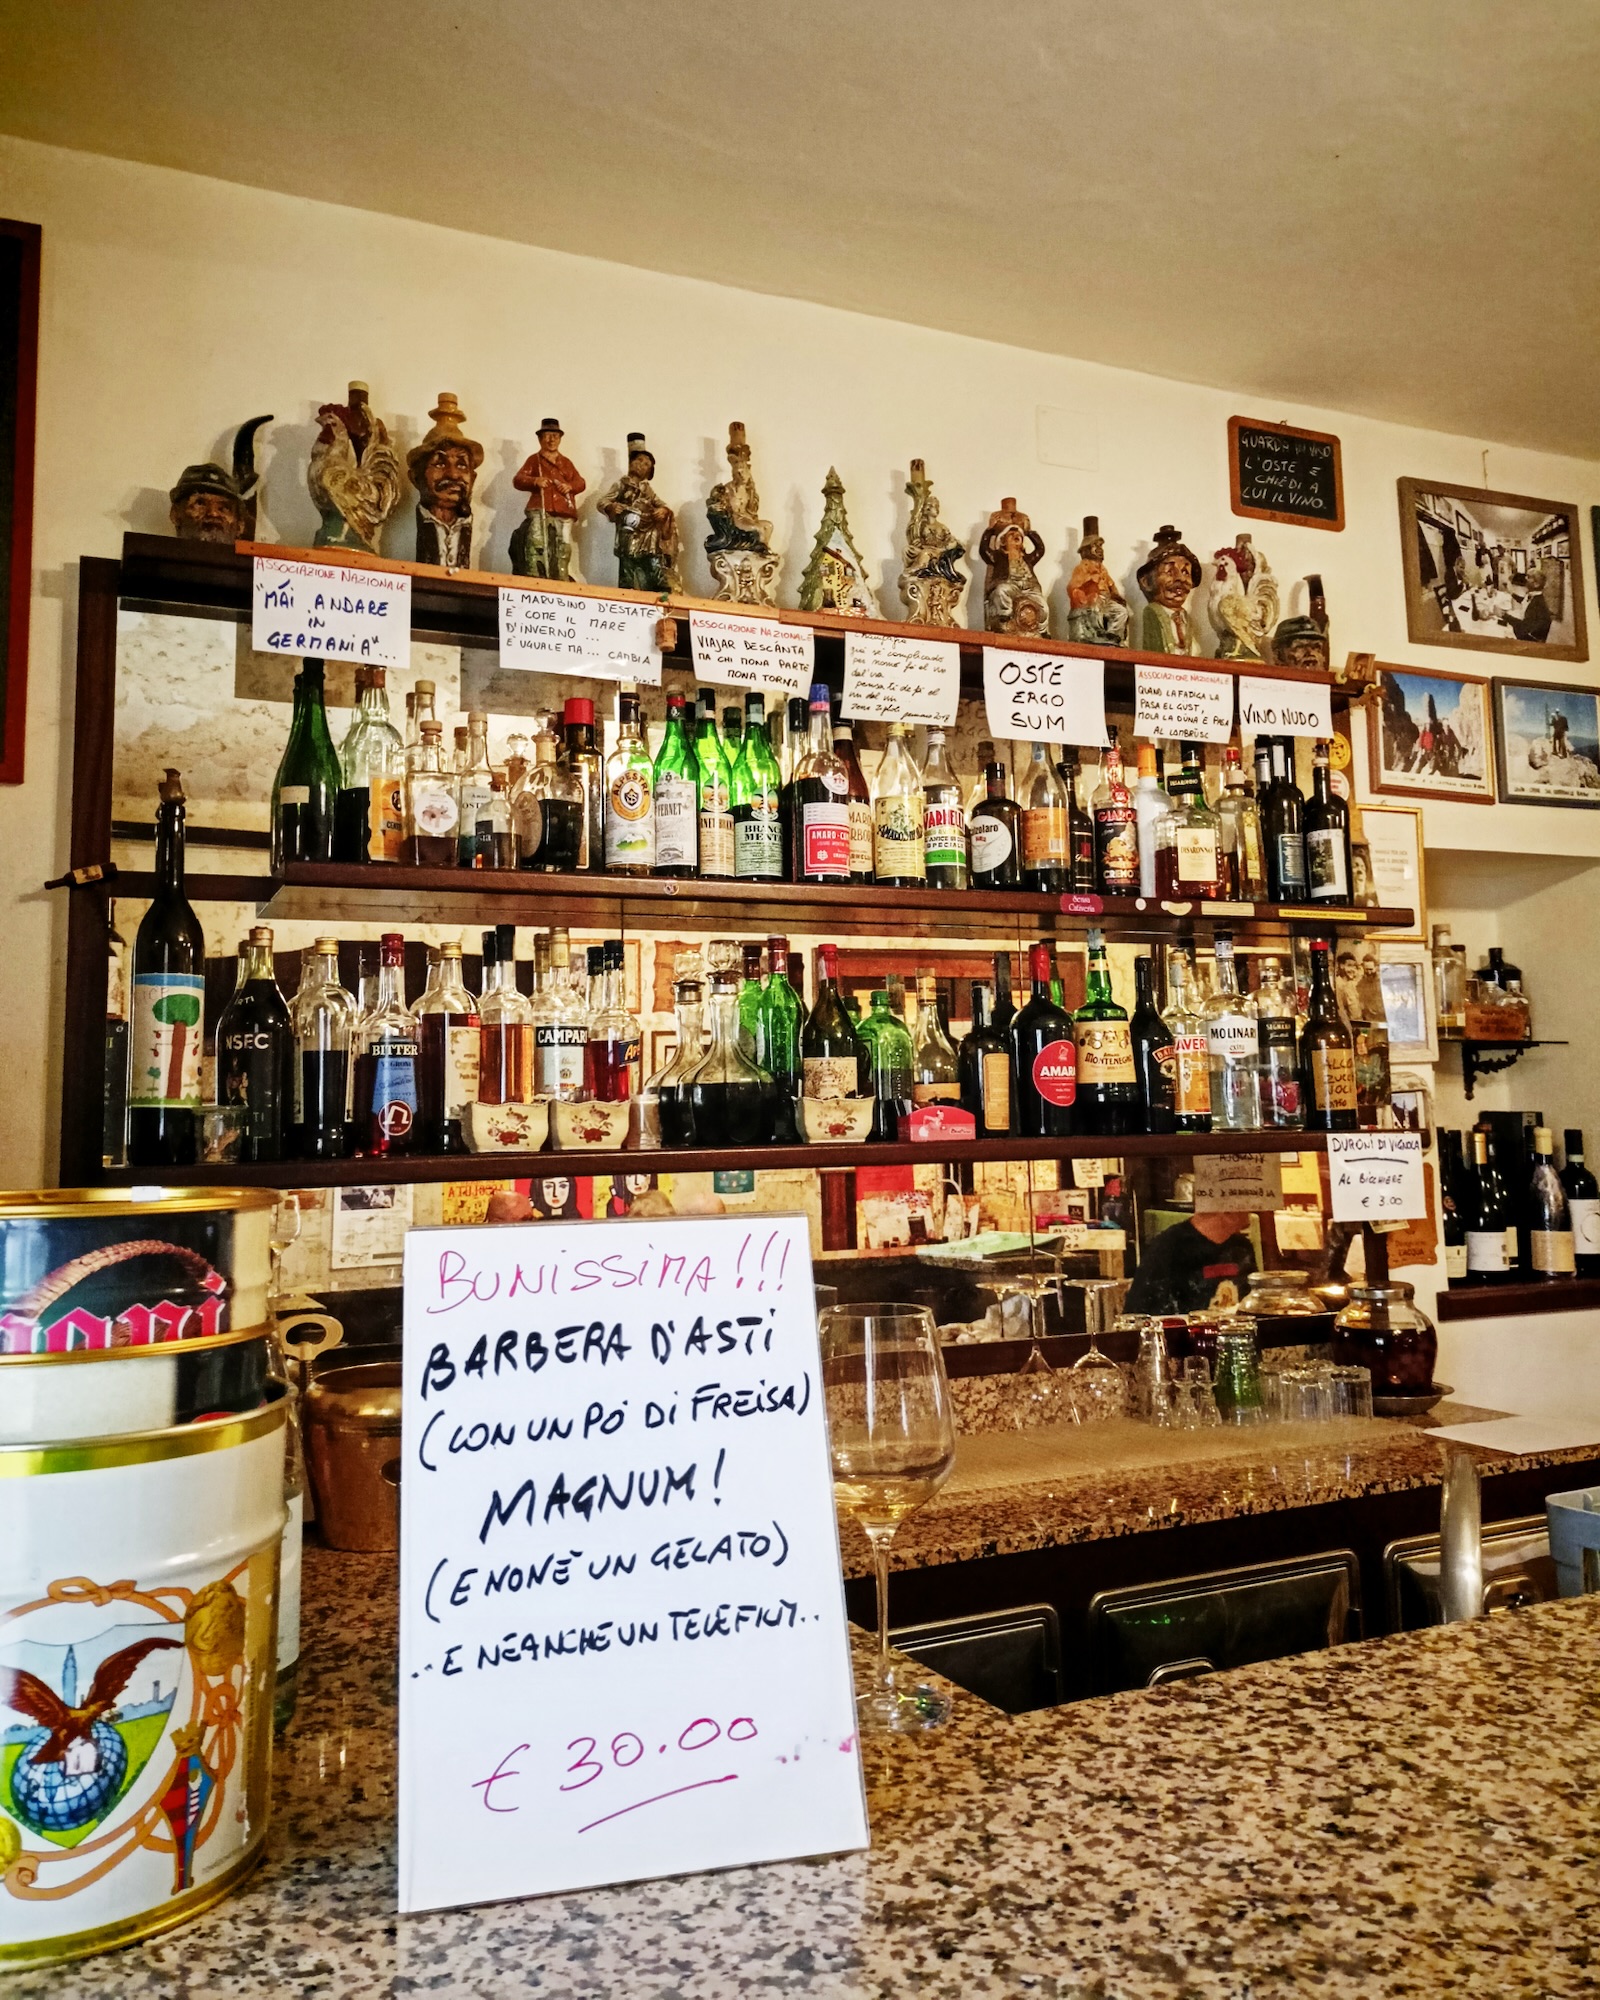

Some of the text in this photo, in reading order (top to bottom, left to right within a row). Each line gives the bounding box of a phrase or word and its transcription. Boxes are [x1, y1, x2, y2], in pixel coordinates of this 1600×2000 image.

[1309, 467, 1321, 476] E
[1255, 475, 1319, 493] CHIEDI A
[1242, 487, 1267, 498] LUI
[1272, 493, 1284, 502] IL
[256, 557, 407, 592] ASSOCIAZIONE NAZIONALE
[315, 593, 389, 617] ANDARE
[502, 593, 656, 619] IL MARUBINO D'ESTATE
[525, 610, 556, 621] COME
[566, 616, 577, 625] IL
[590, 618, 626, 632] MARE
[692, 619, 813, 641] ASSOCIAZIONE NAZIONALE
[506, 622, 576, 639] D'INVERNO
[520, 640, 562, 651] UGUALE
[608, 651, 650, 665] CAMBIA
[697, 635, 736, 652] VIAJAR
[741, 658, 769, 667] MONA
[779, 659, 809, 672] PARTE
[727, 670, 798, 688] MONA TORNA
[1139, 671, 1230, 685] ASSOCIAZIONE NAZIONALE
[1012, 691, 1064, 707] ERGO
[1140, 699, 1160, 709] PASA
[1010, 712, 1064, 731] SUM
[1138, 711, 1159, 721] MOLA
[1213, 715, 1229, 727] PASA
[1243, 703, 1319, 727] VINO NUDO
[1153, 726, 1163, 735] AL
[612, 771, 650, 797] ALPESTRE
[538, 1029, 588, 1044] CAMPARI
[1210, 1026, 1257, 1040] MOLINARI
[372, 1044, 419, 1056] BITTER
[1332, 1137, 1420, 1152] DURONI DI VIGNOLA
[1339, 1172, 1403, 1186] AL BICCHIERE
[1361, 1195, 1403, 1207] € 3.00
[421, 1308, 776, 1400] BARBERA D'ASTI
[419, 1410, 515, 1472] (CON
[527, 1415, 573, 1442] UN
[645, 1390, 679, 1430] DI
[691, 1372, 811, 1423] FREISA)
[478, 1448, 726, 1545] MAGNUM!
[425, 1558, 478, 1624] (E
[485, 1553, 556, 1596] NON
[588, 1552, 636, 1581] UN
[650, 1521, 789, 1572] GELATO)
[478, 1621, 612, 1670] NEANCHE
[618, 1622, 658, 1647] UN
[471, 1717, 758, 1812] € 30.00
